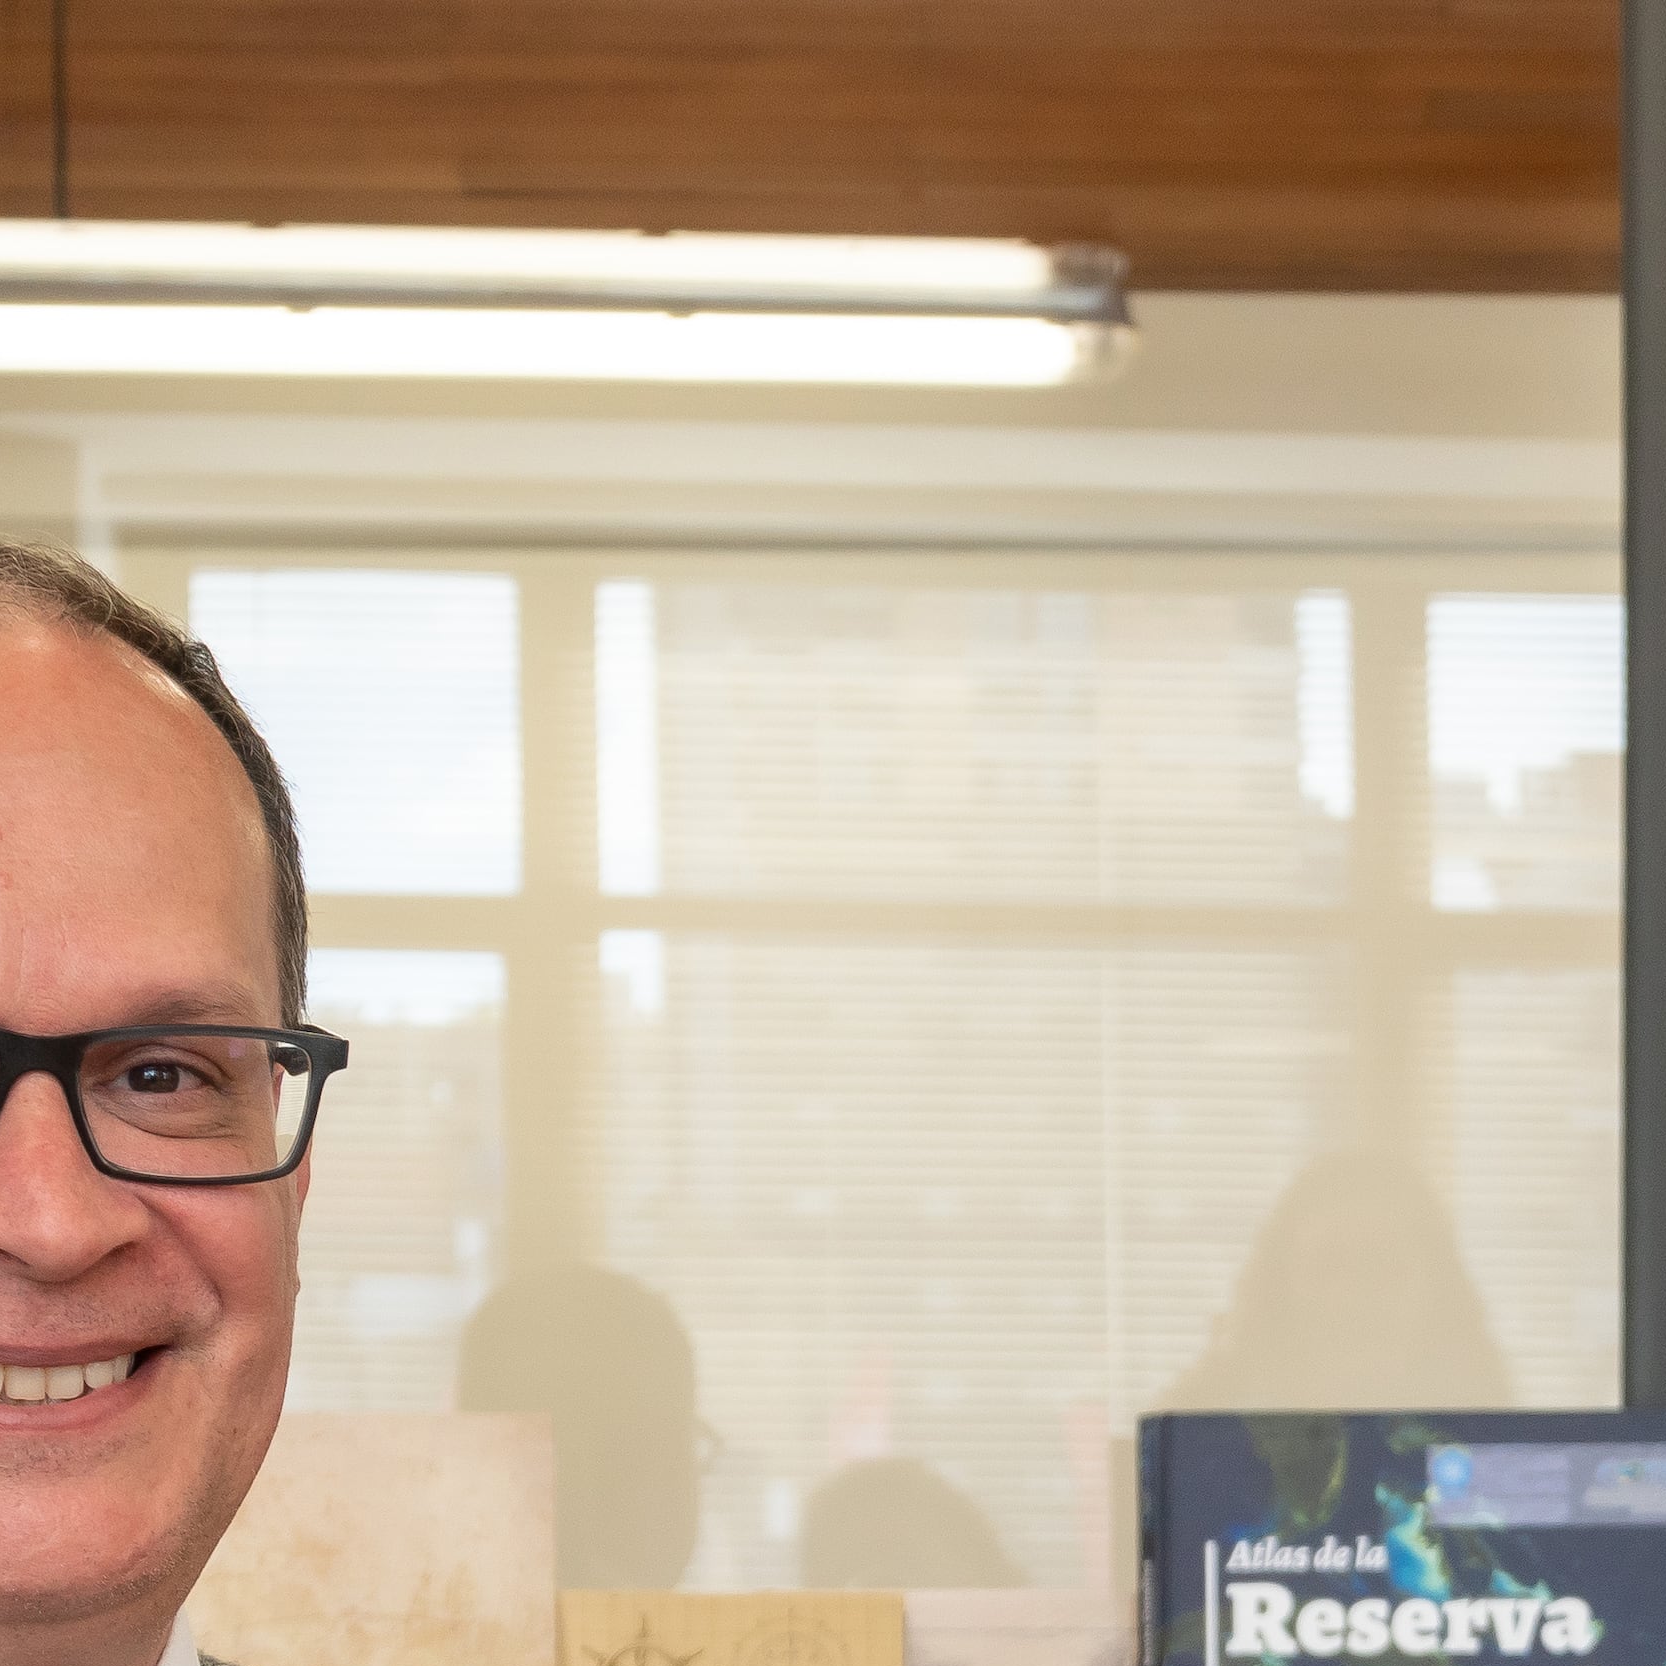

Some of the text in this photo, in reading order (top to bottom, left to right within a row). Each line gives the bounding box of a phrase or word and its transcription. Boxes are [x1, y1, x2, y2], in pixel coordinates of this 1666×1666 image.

[1226, 1537, 1388, 1571] Atlas de la
[1225, 1581, 1597, 1657] Reserva
